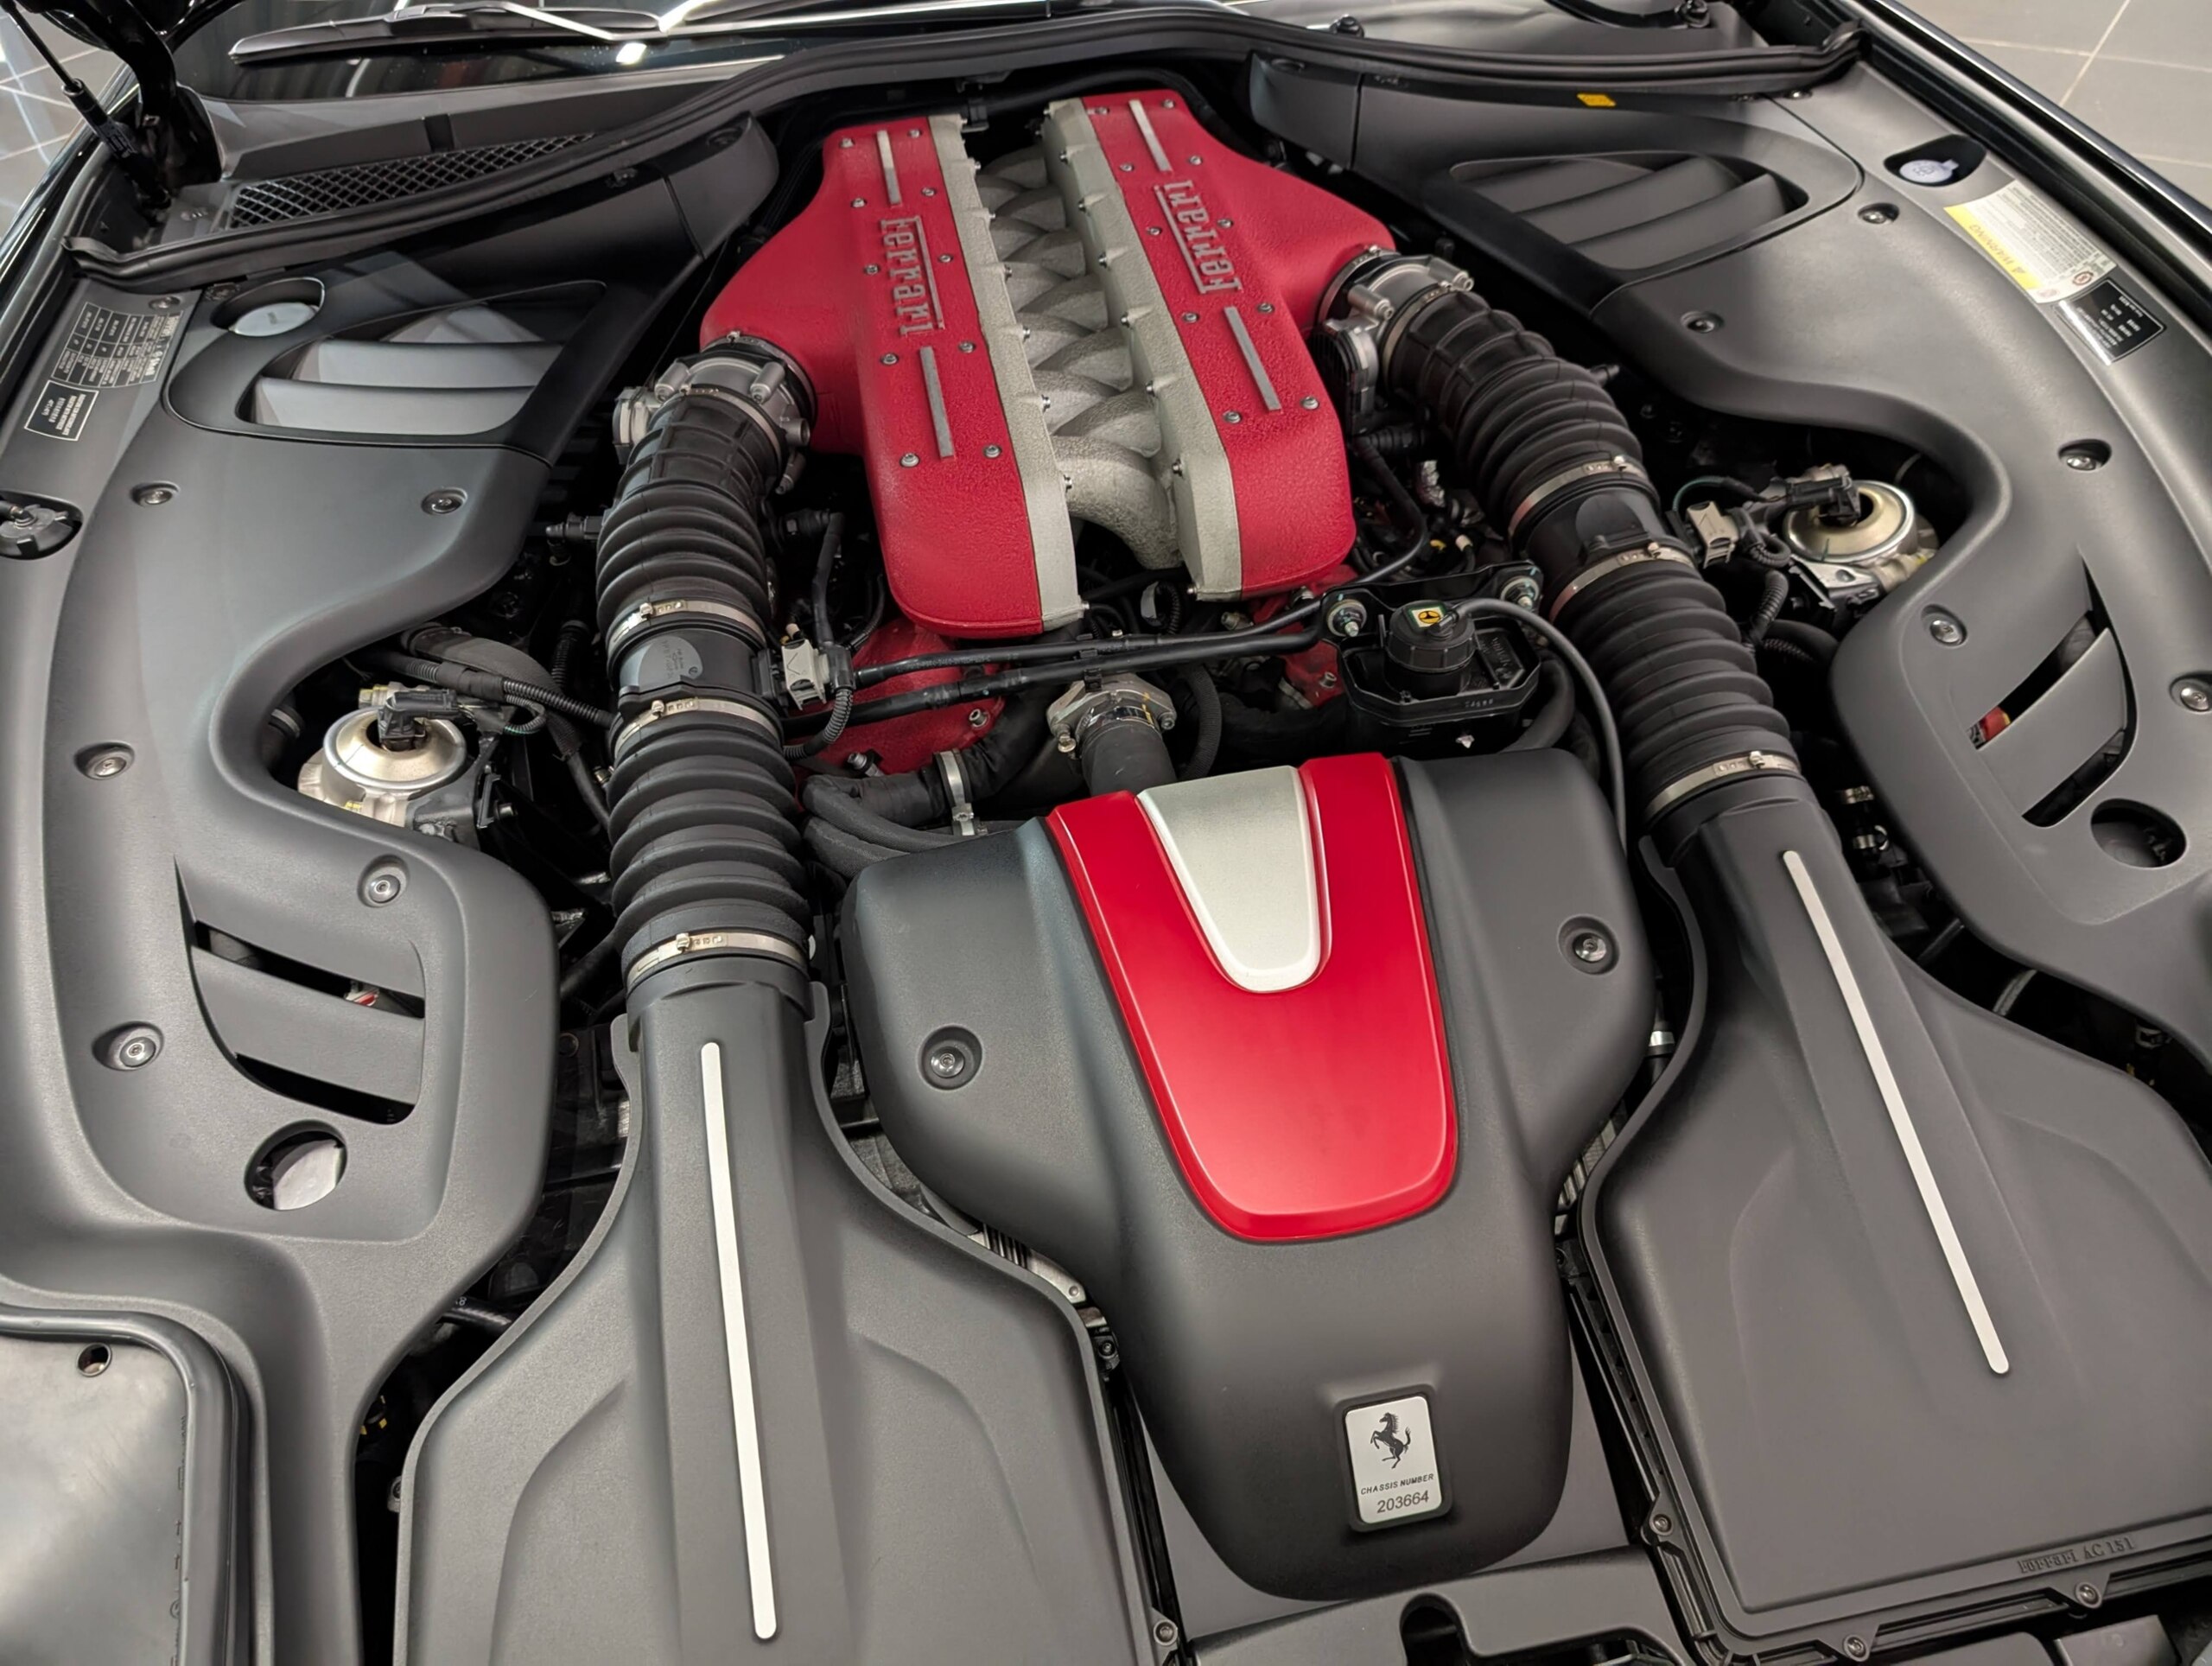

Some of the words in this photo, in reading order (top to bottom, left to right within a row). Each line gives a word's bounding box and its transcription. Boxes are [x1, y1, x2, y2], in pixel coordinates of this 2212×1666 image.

[1154, 180, 1243, 295] Ferrari
[1967, 223, 2015, 265] WARNING
[880, 215, 945, 336] Ferrari
[1360, 1481, 1398, 1495] CHASSIS
[1400, 1473, 1434, 1486] NUMBER
[1376, 1490, 1429, 1513] 203664
[2018, 1549, 2080, 1574] Ferrari
[2084, 1543, 2105, 1560] AC
[2107, 1536, 2136, 1553] 151
